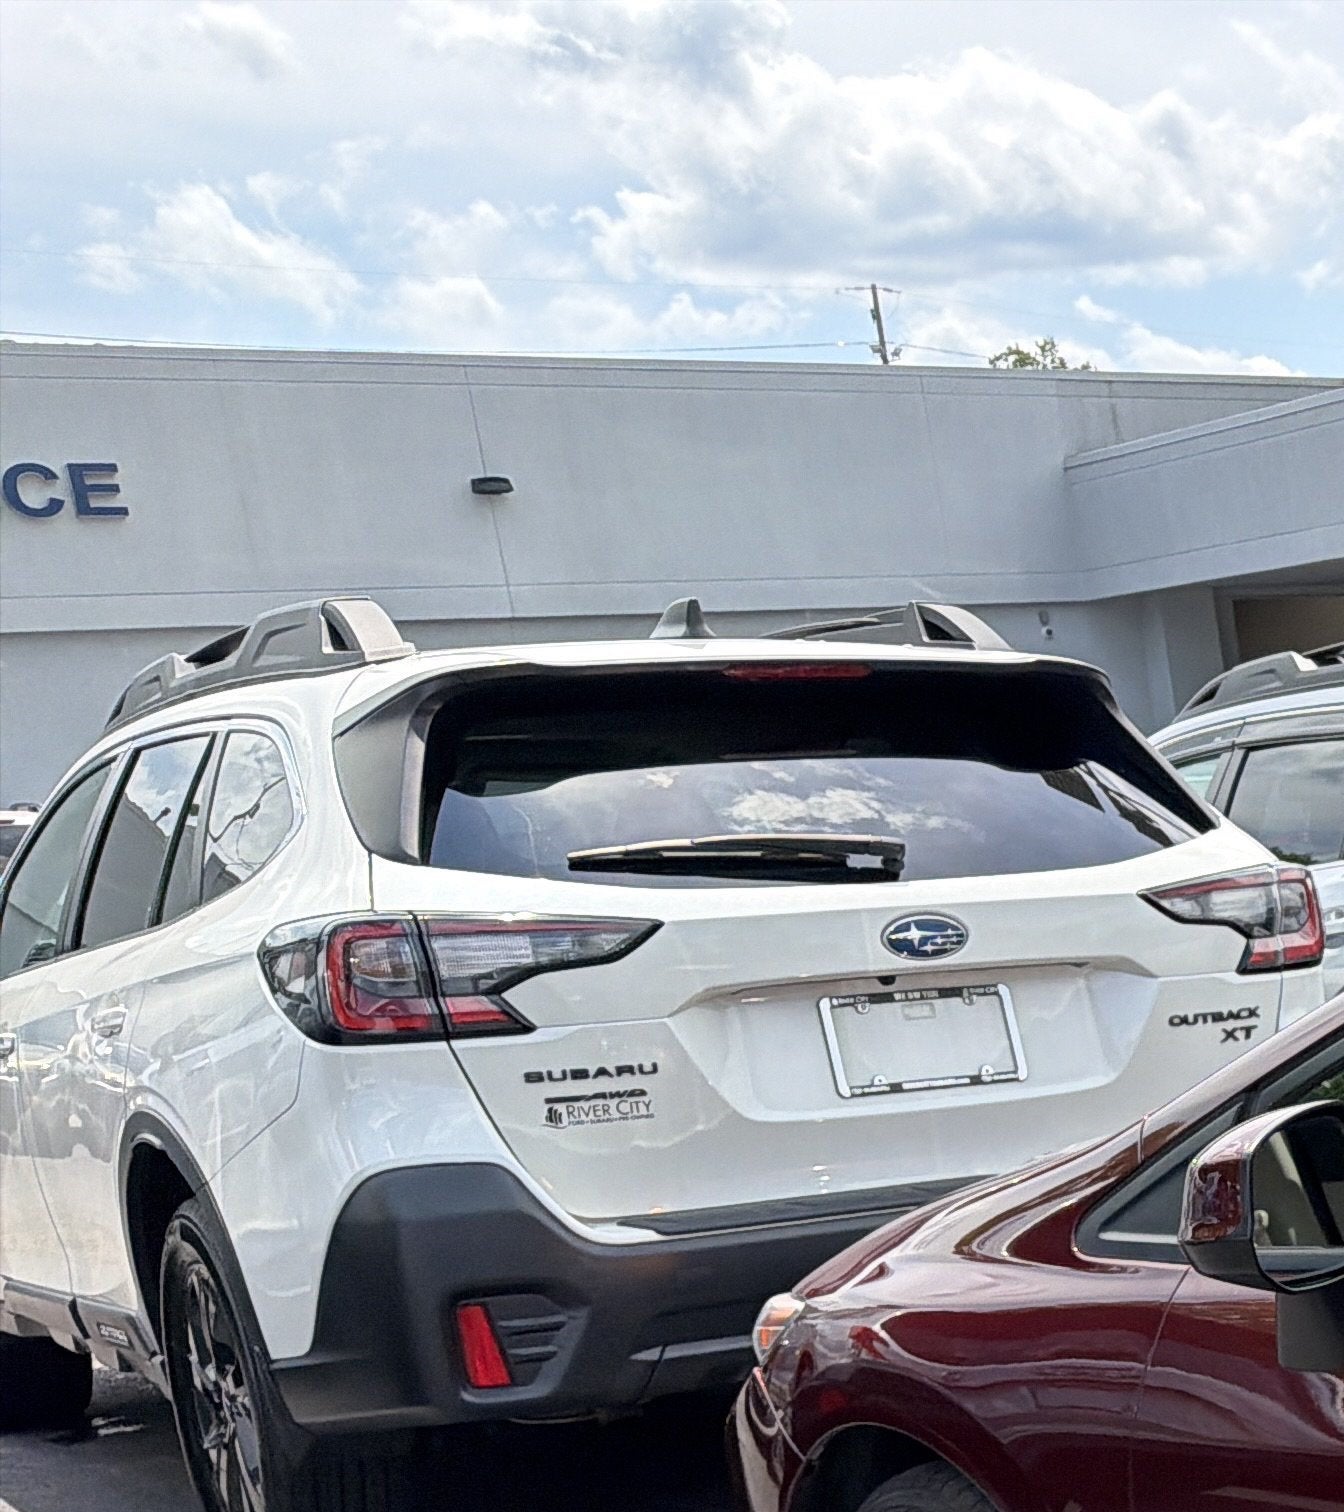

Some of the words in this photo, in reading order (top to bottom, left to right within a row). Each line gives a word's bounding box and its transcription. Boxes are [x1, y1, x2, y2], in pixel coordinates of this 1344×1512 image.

[2, 462, 129, 518] CE
[1168, 1005, 1260, 1027] OUTBACK
[1220, 1024, 1258, 1043] XT
[523, 1061, 659, 1084] SUBARU
[566, 1103, 612, 1120] RIVER
[616, 1099, 652, 1116] CITY
